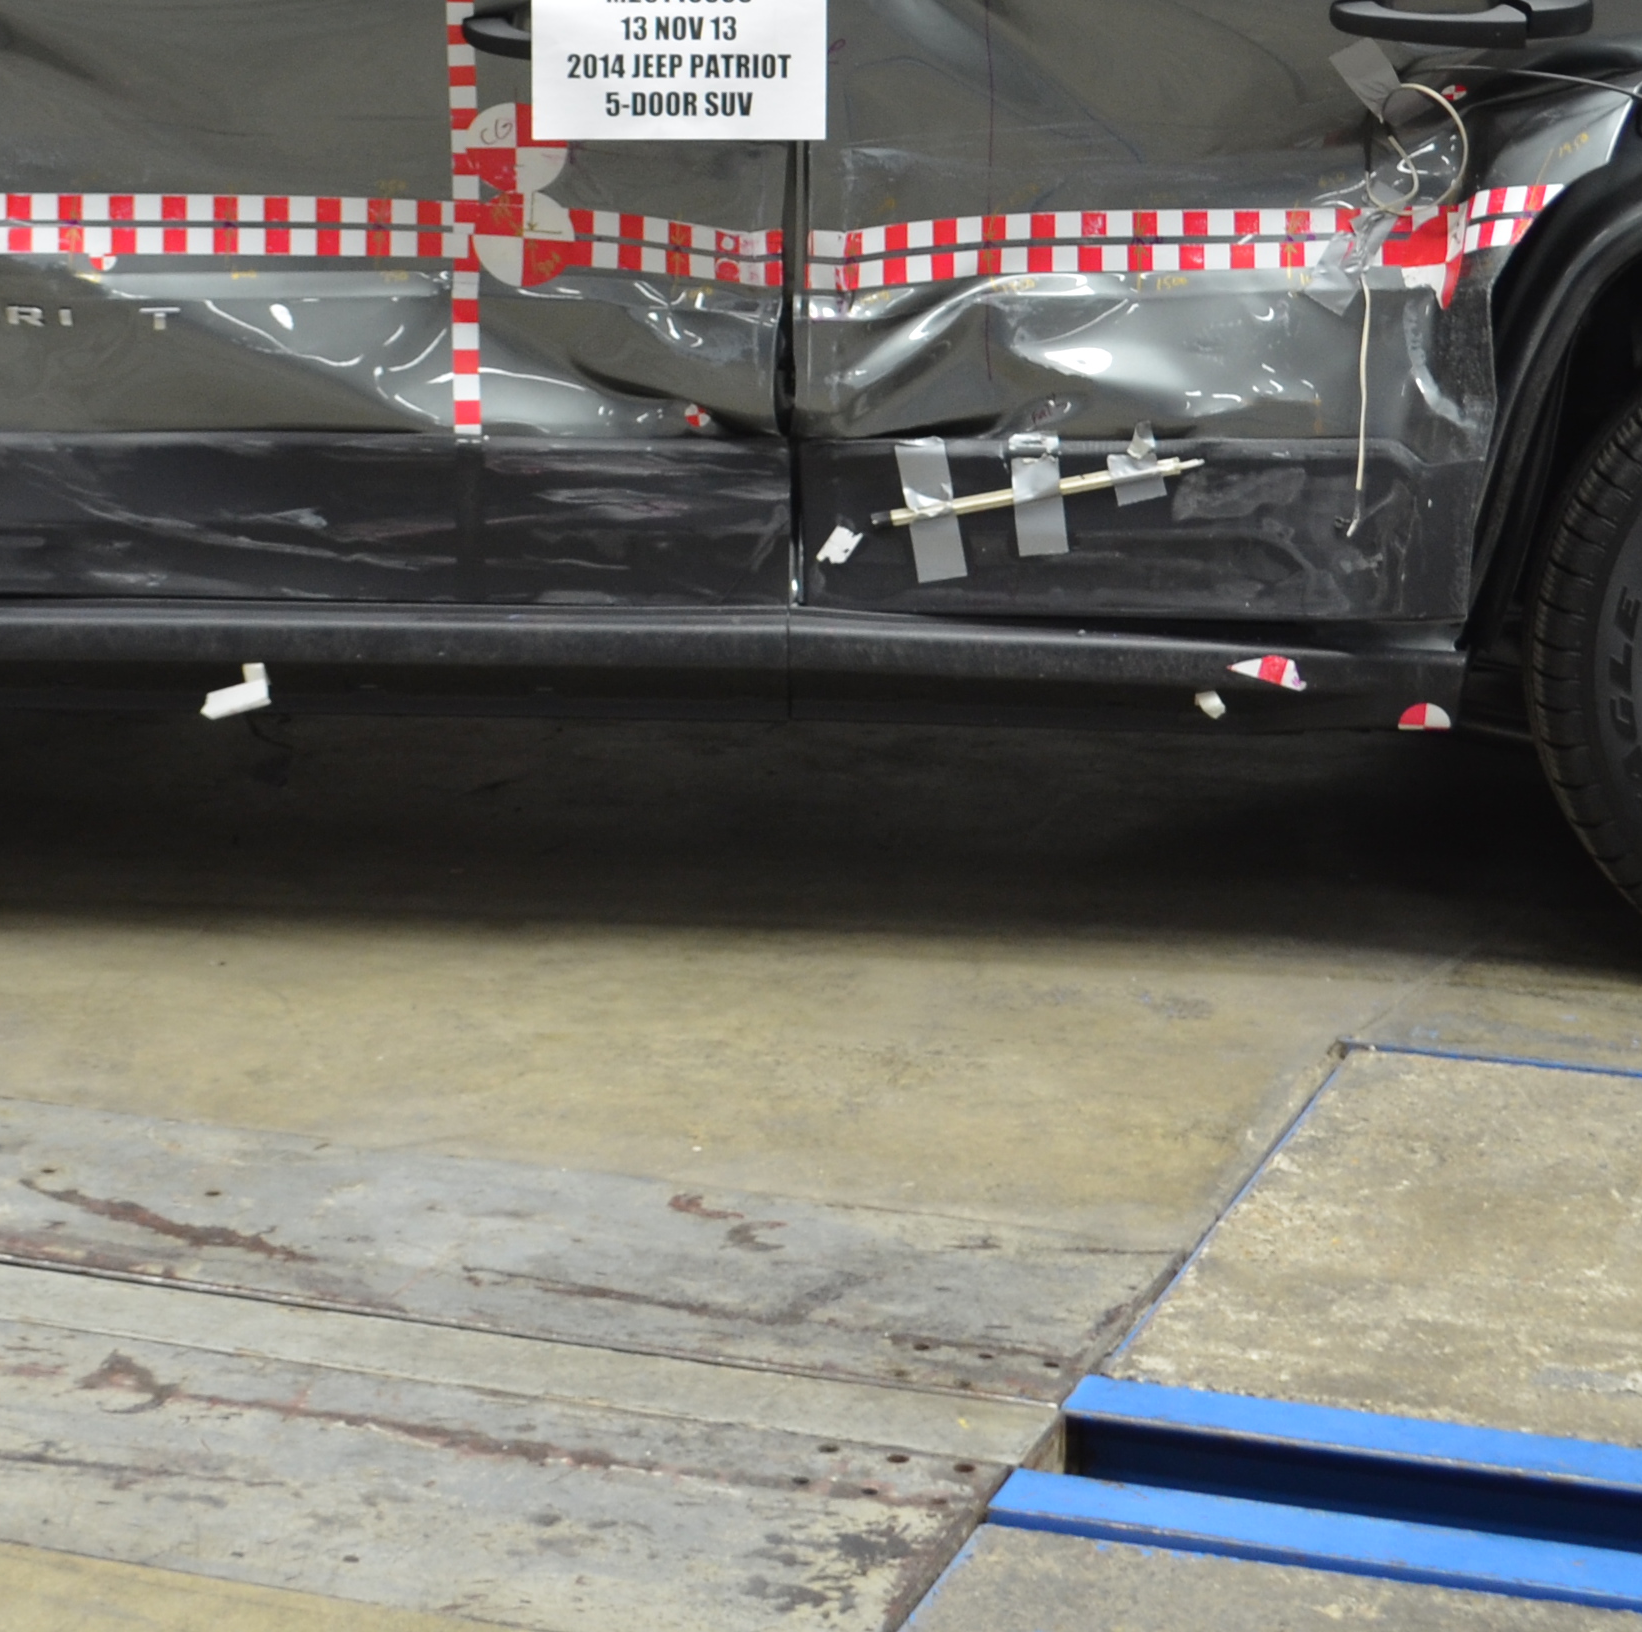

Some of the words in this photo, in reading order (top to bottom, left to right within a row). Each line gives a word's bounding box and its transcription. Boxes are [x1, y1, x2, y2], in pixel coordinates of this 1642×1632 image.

[620, 16, 648, 41] 13
[655, 16, 705, 41] NOV
[711, 16, 738, 41] 13
[566, 53, 626, 79] 2014
[631, 54, 684, 79] JEEP
[689, 54, 793, 79] PATRIOT
[605, 91, 698, 117] 5-DOOR
[704, 91, 754, 117] SUV
